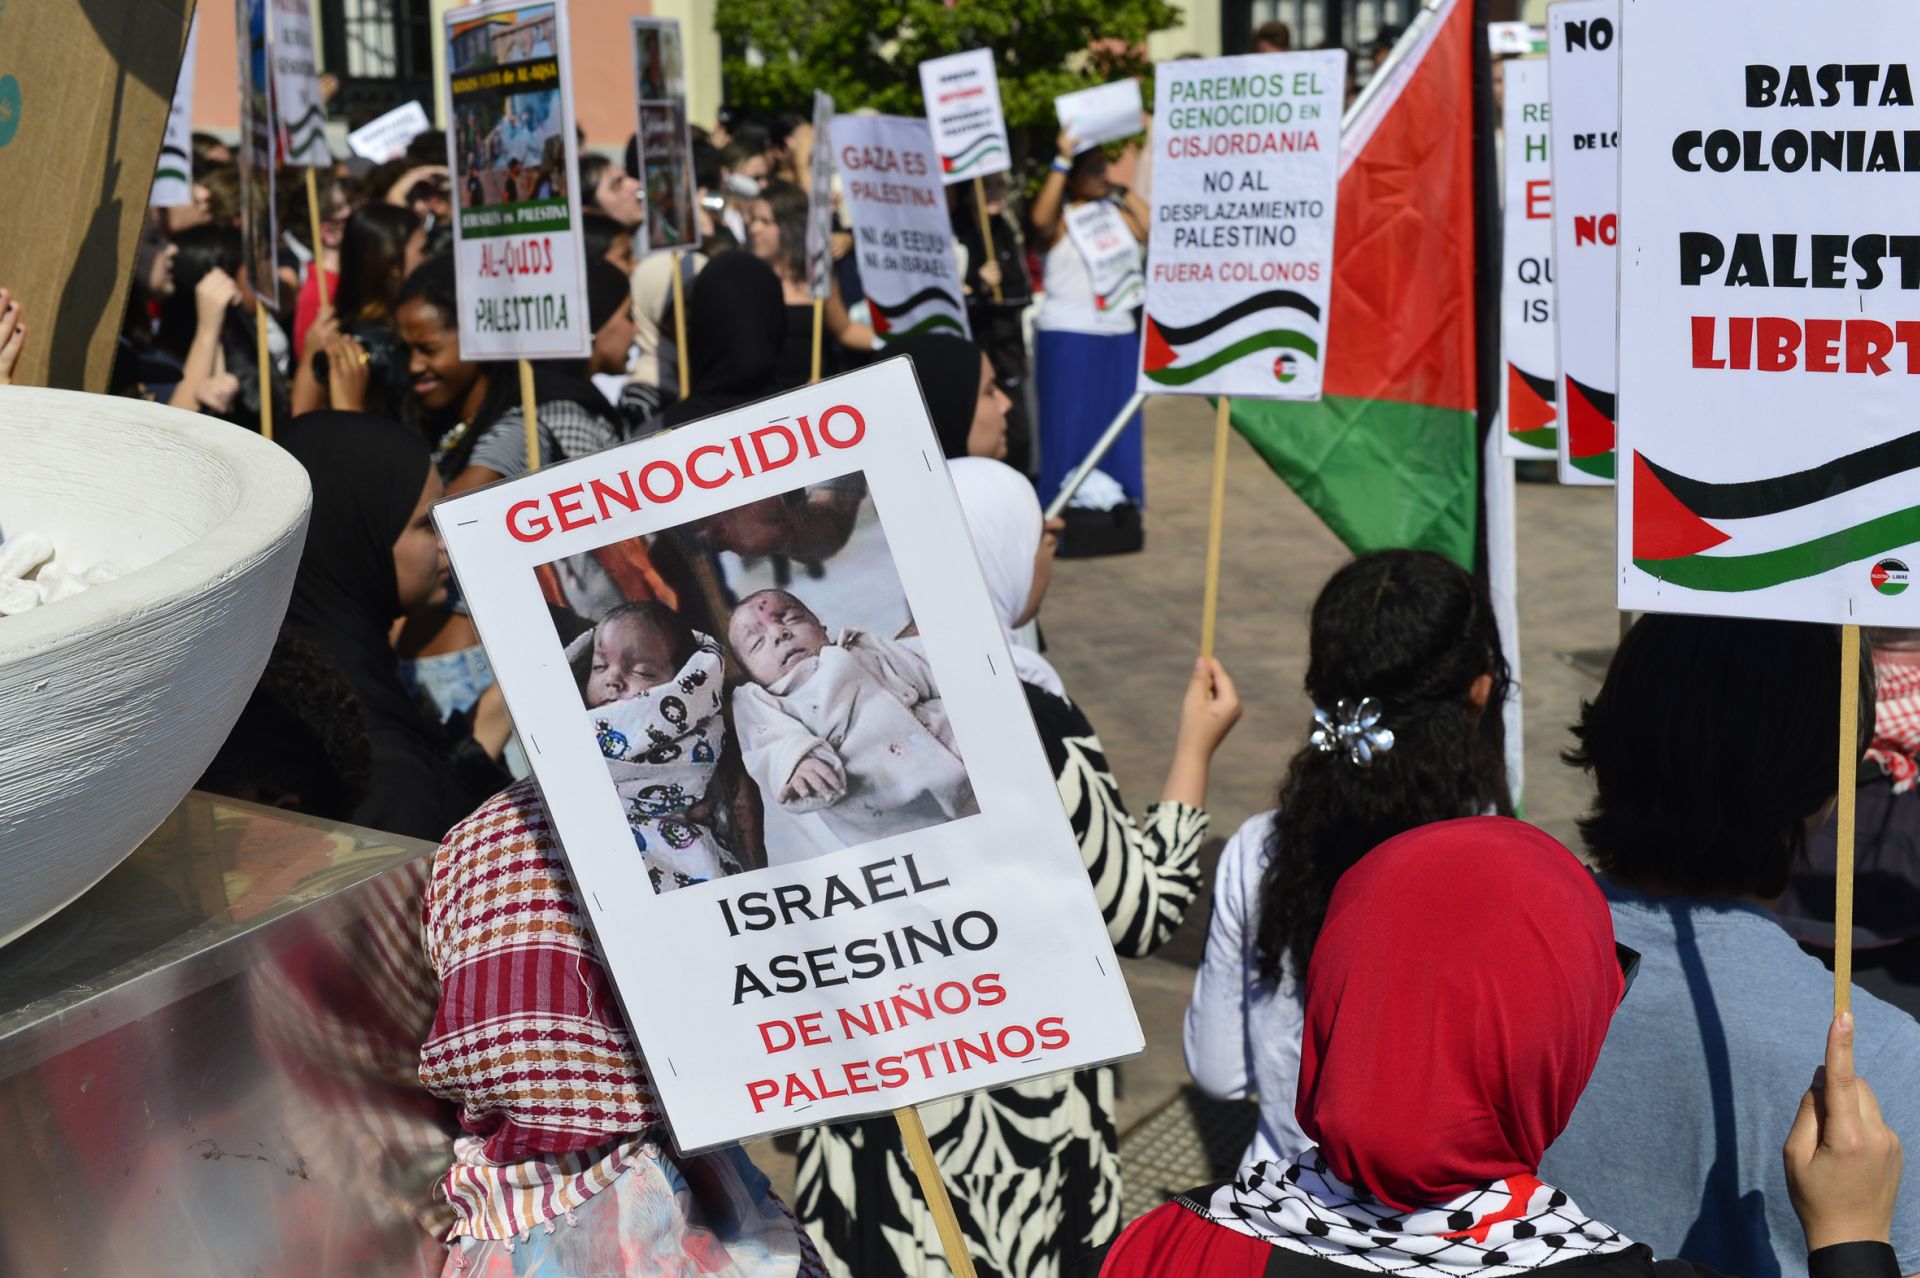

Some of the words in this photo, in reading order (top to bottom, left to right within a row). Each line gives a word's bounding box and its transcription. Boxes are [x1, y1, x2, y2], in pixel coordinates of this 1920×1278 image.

[1564, 17, 1614, 52] NO
[1170, 74, 1284, 103] PAREMOS
[1292, 72, 1324, 97] EL
[1745, 64, 1915, 108] BASTA
[1168, 102, 1293, 130] GENOCIDIO
[1299, 104, 1321, 120] EN
[1167, 130, 1319, 159] CISJORDANIA
[1573, 133, 1596, 151] DE
[842, 145, 899, 174] GAZA
[902, 151, 928, 177] ES
[850, 181, 937, 208] PALESTINA
[1203, 171, 1235, 193] NO
[1239, 170, 1269, 192] AL
[1160, 200, 1324, 223] DESPLAZAMIENTO
[1174, 225, 1296, 248] PALESTINO
[1574, 213, 1617, 247] NO
[1154, 262, 1214, 284] FUERA
[1218, 262, 1321, 283] COLONOS
[475, 294, 569, 332] PALESTINA
[1523, 299, 1549, 324] IS
[505, 404, 866, 543] GENOCIDIO
[716, 853, 951, 938] ISRAEL
[731, 910, 999, 1006] ASESINO
[756, 1010, 833, 1055] DE
[836, 972, 1008, 1040] NIÑOS
[744, 1016, 1071, 1114] PALESTINOS
